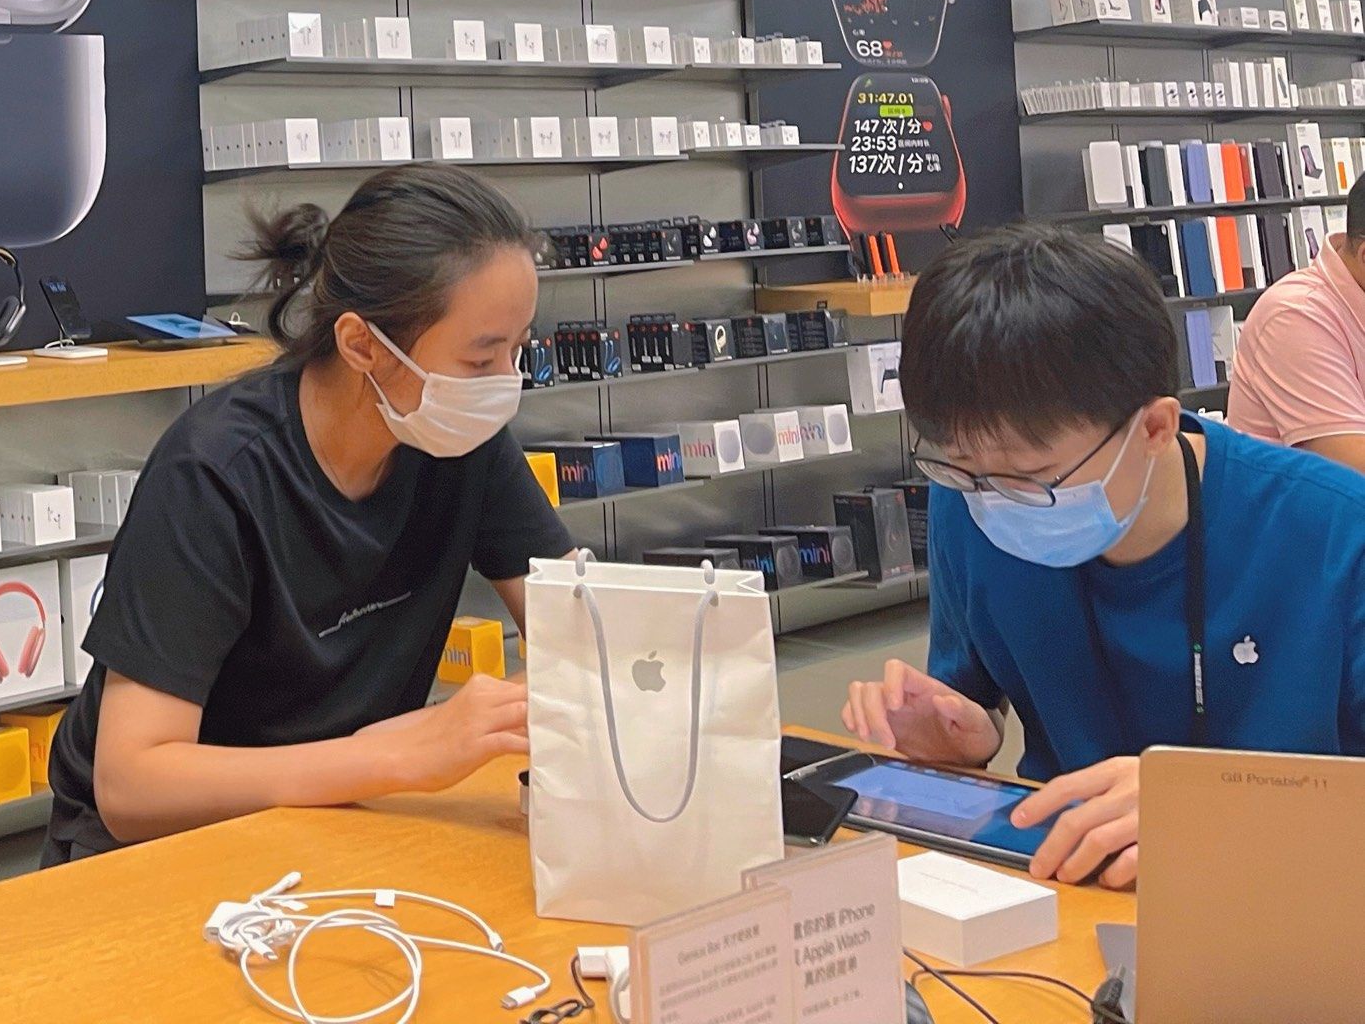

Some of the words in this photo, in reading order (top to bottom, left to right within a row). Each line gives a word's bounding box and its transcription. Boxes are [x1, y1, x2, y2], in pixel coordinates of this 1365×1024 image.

[856, 40, 884, 57] 68
[857, 92, 914, 105] 31:47.01
[851, 135, 897, 152] 23:53
